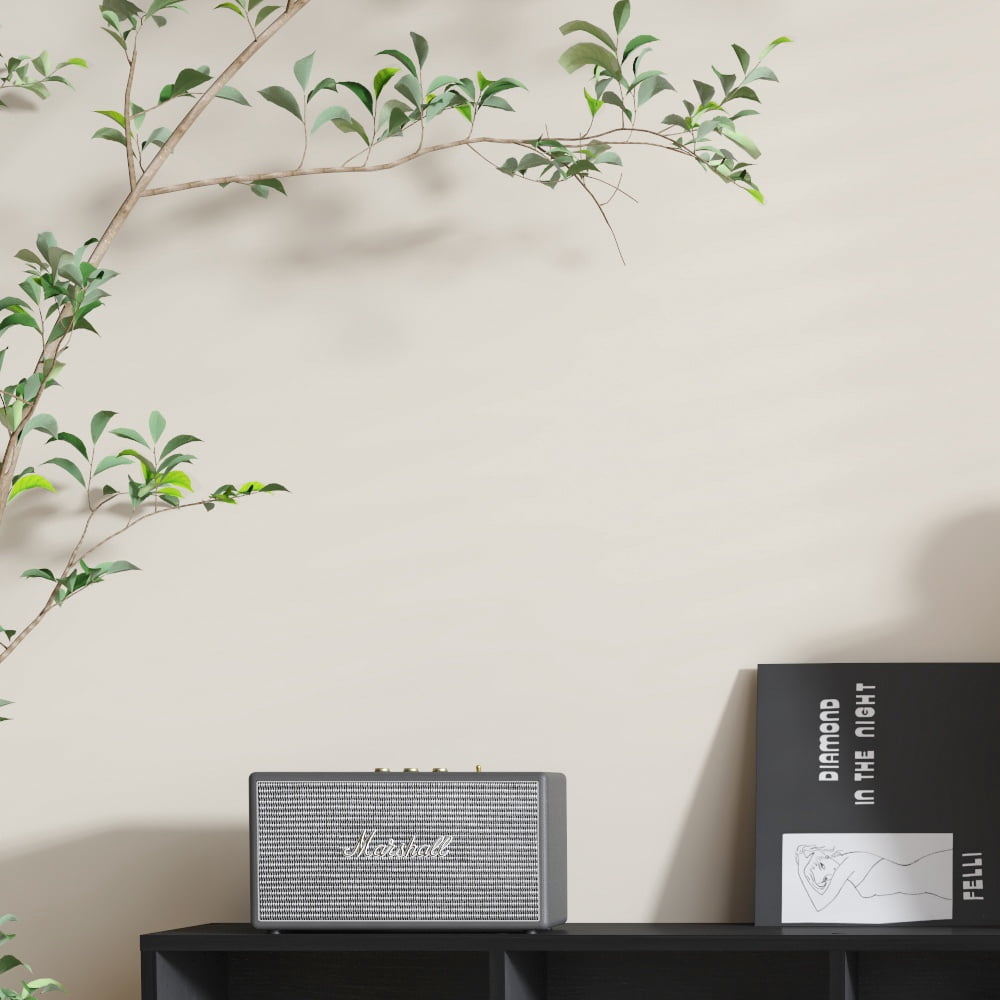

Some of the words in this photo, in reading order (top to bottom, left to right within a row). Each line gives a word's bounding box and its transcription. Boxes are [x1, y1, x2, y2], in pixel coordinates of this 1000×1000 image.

[855, 683, 876, 738] NIGHT
[818, 698, 840, 782] DIAMOND
[854, 750, 875, 782] THE
[343, 829, 453, 858] Marshall
[962, 852, 984, 901] FELLI
